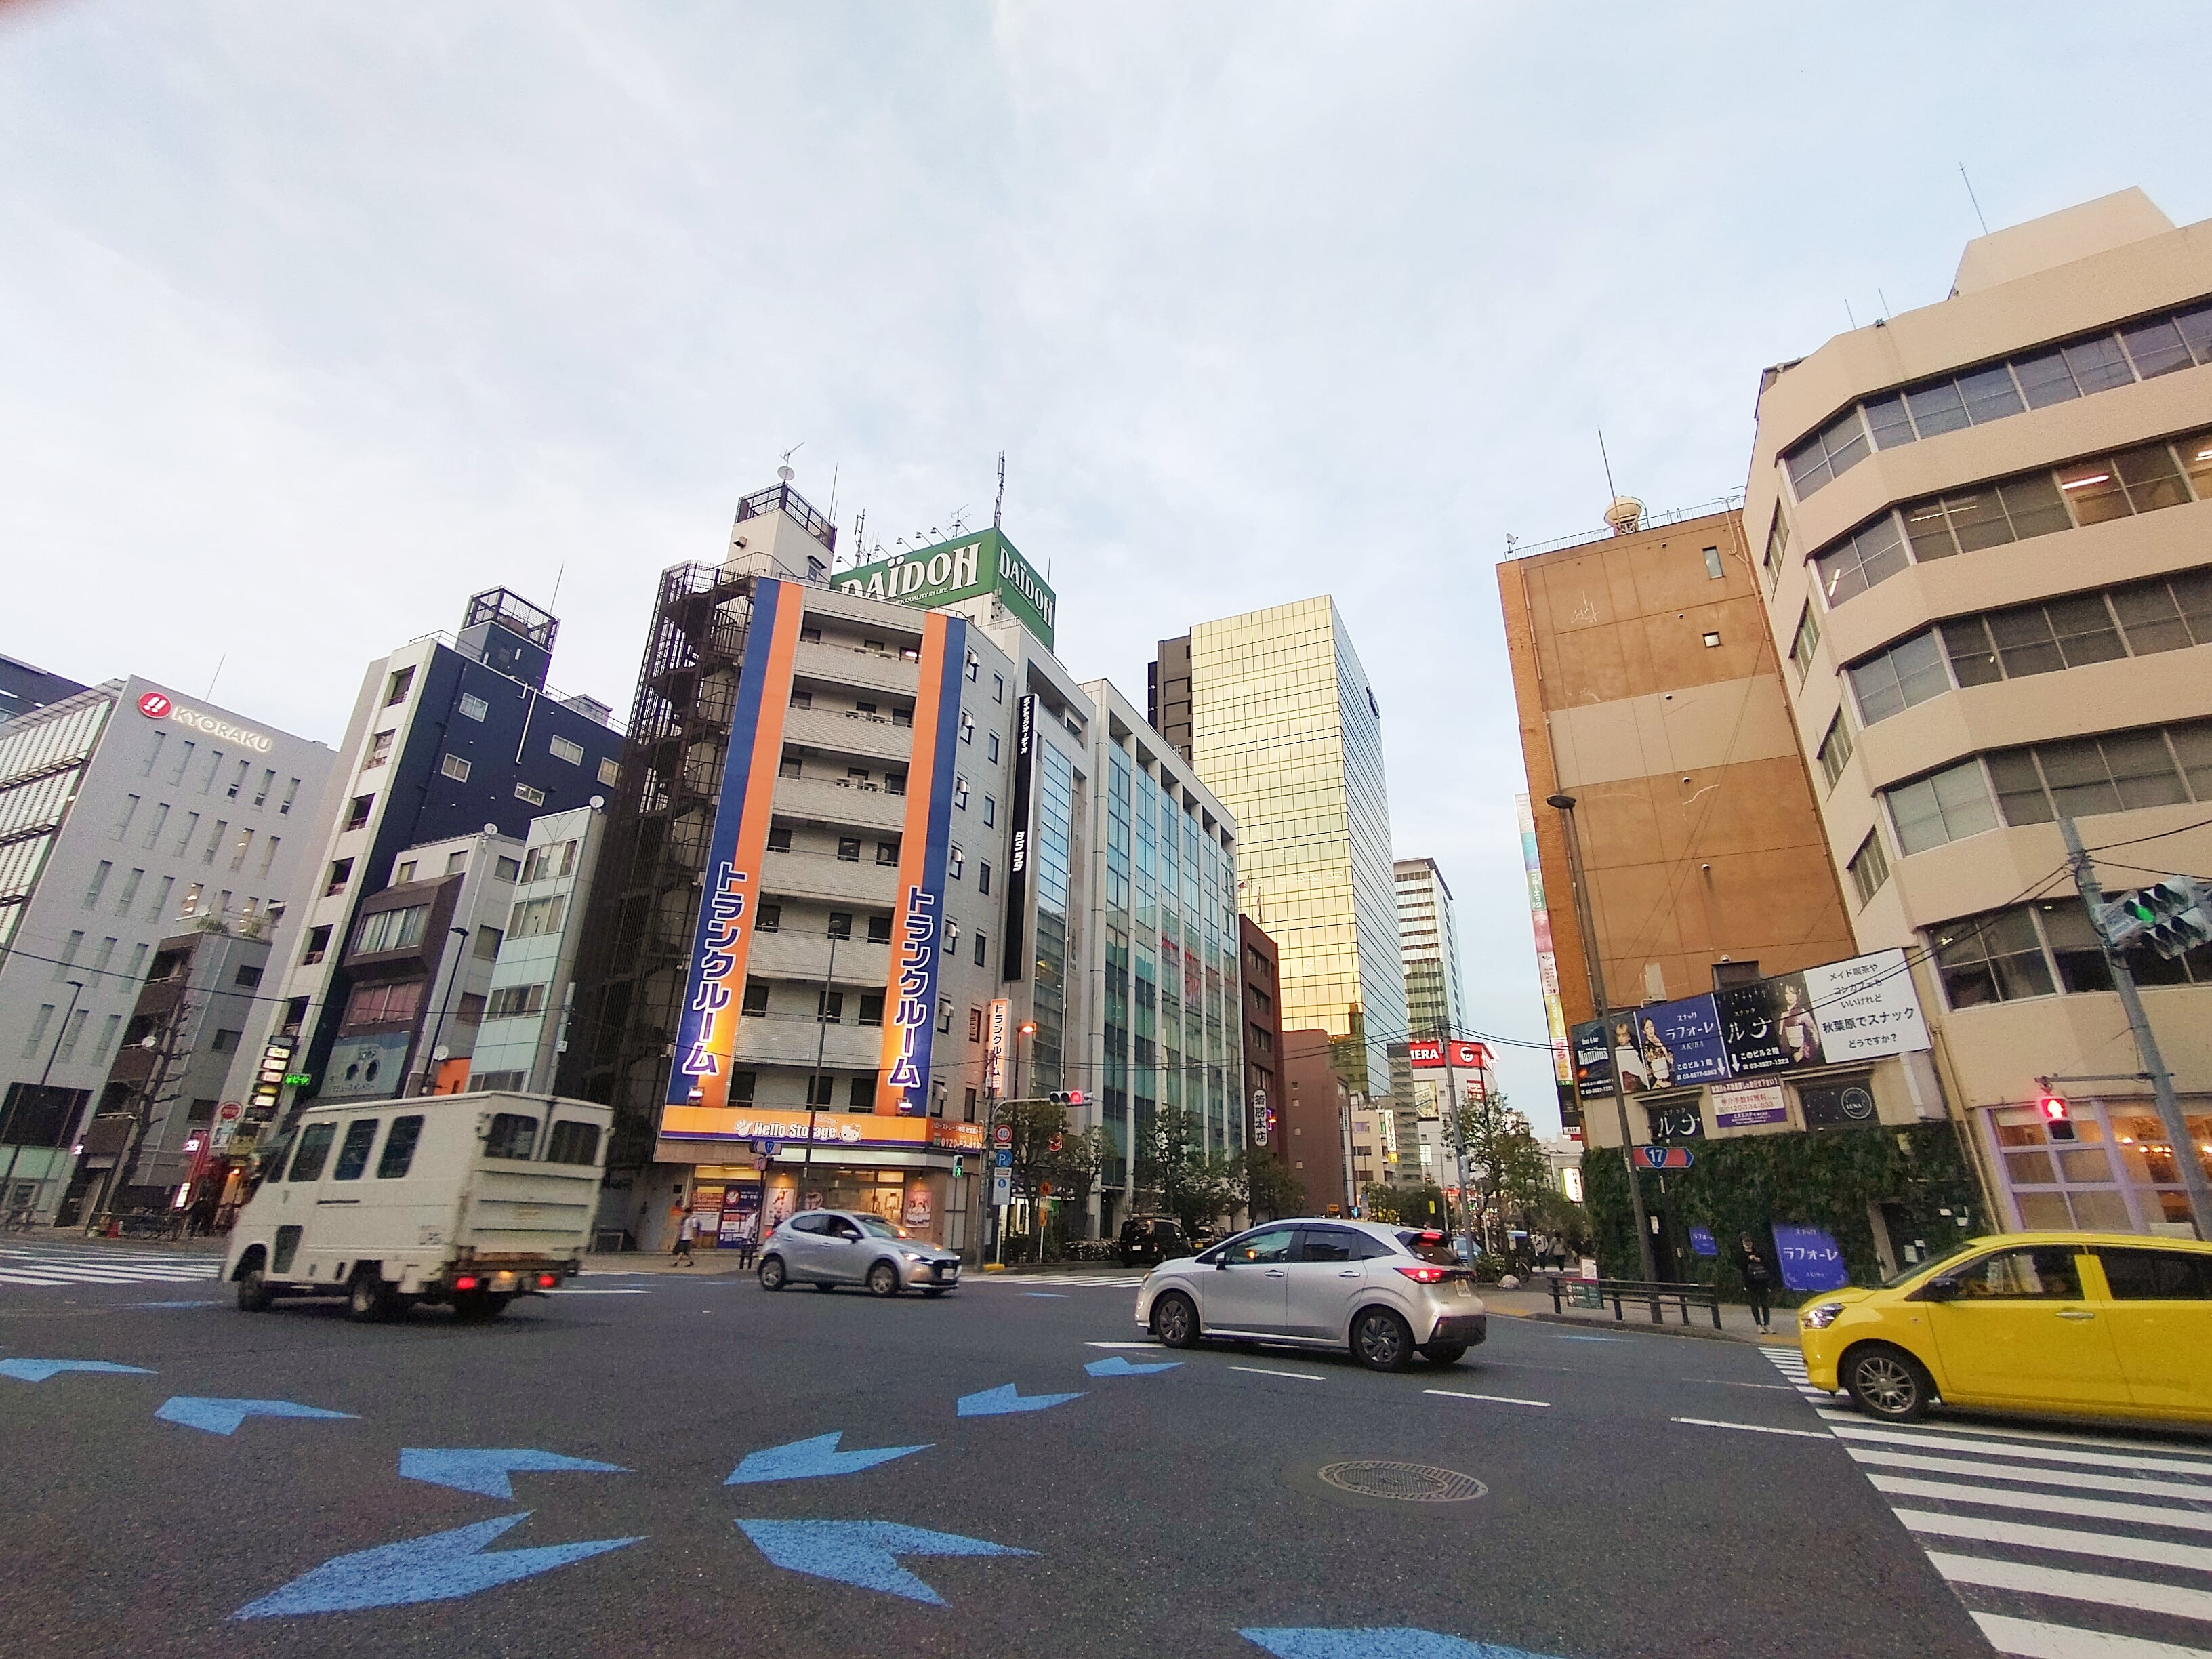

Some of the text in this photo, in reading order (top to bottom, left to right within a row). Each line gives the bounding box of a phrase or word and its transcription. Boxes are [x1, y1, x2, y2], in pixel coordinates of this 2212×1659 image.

[173, 705, 272, 752] KYORAKU
[1012, 831, 1025, 872] 5555
[682, 861, 748, 1076] トランクルーム
[1830, 963, 1878, 981] メイド喫茶や
[887, 885, 935, 1088] トランクルーム
[1841, 994, 1882, 1008] いいけれど
[1677, 1012, 1697, 1022] スナック
[1822, 1007, 1914, 1034] 秋葉原でスナック
[993, 1004, 1004, 1076] トランクルーム
[1666, 1022, 1714, 1040] ラフォーレ
[754, 1122, 837, 1140] Hello Stoage
[999, 1153, 1006, 1165] P
[1648, 1149, 1664, 1162] 17
[1783, 1247, 1839, 1261] ラフォーレ
